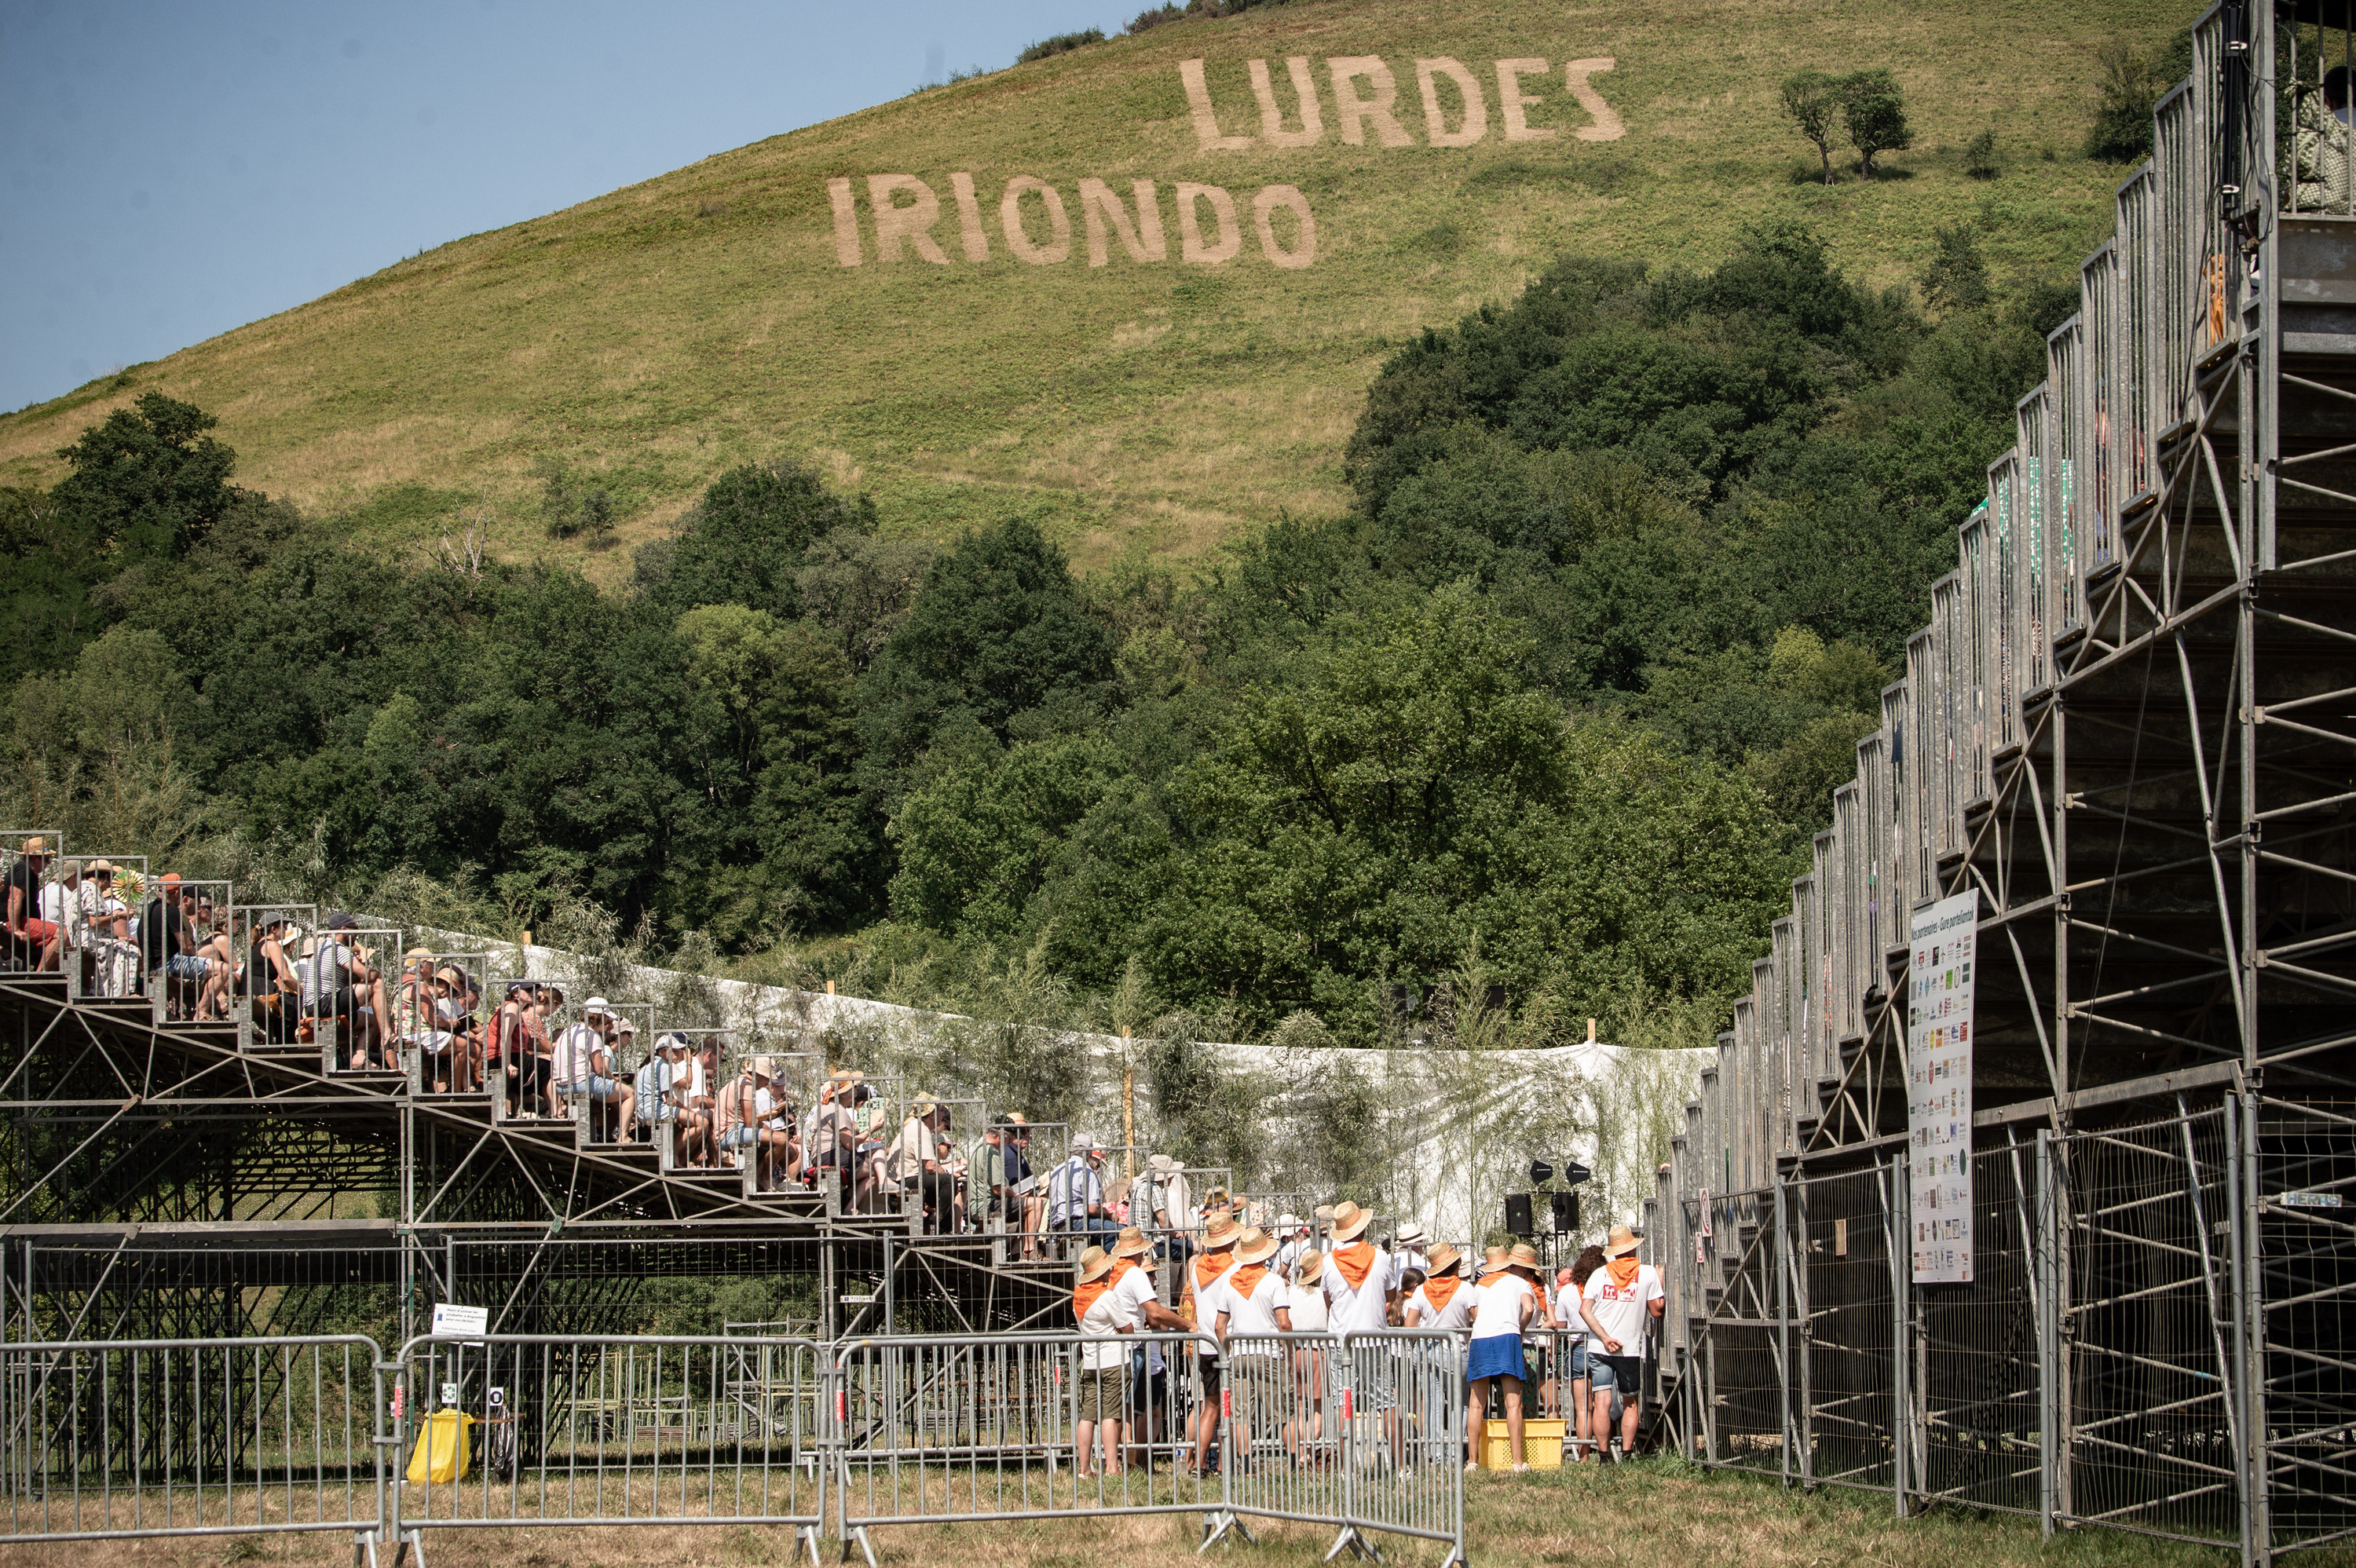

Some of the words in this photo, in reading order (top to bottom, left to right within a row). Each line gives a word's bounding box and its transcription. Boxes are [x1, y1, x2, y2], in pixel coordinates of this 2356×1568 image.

[1177, 54, 1626, 152] LURDES
[827, 171, 1317, 269] IRIONDO
[1917, 920, 1938, 943] partenaires
[1940, 916, 1949, 931] Gure
[2287, 1193, 2339, 1206] HERAS
